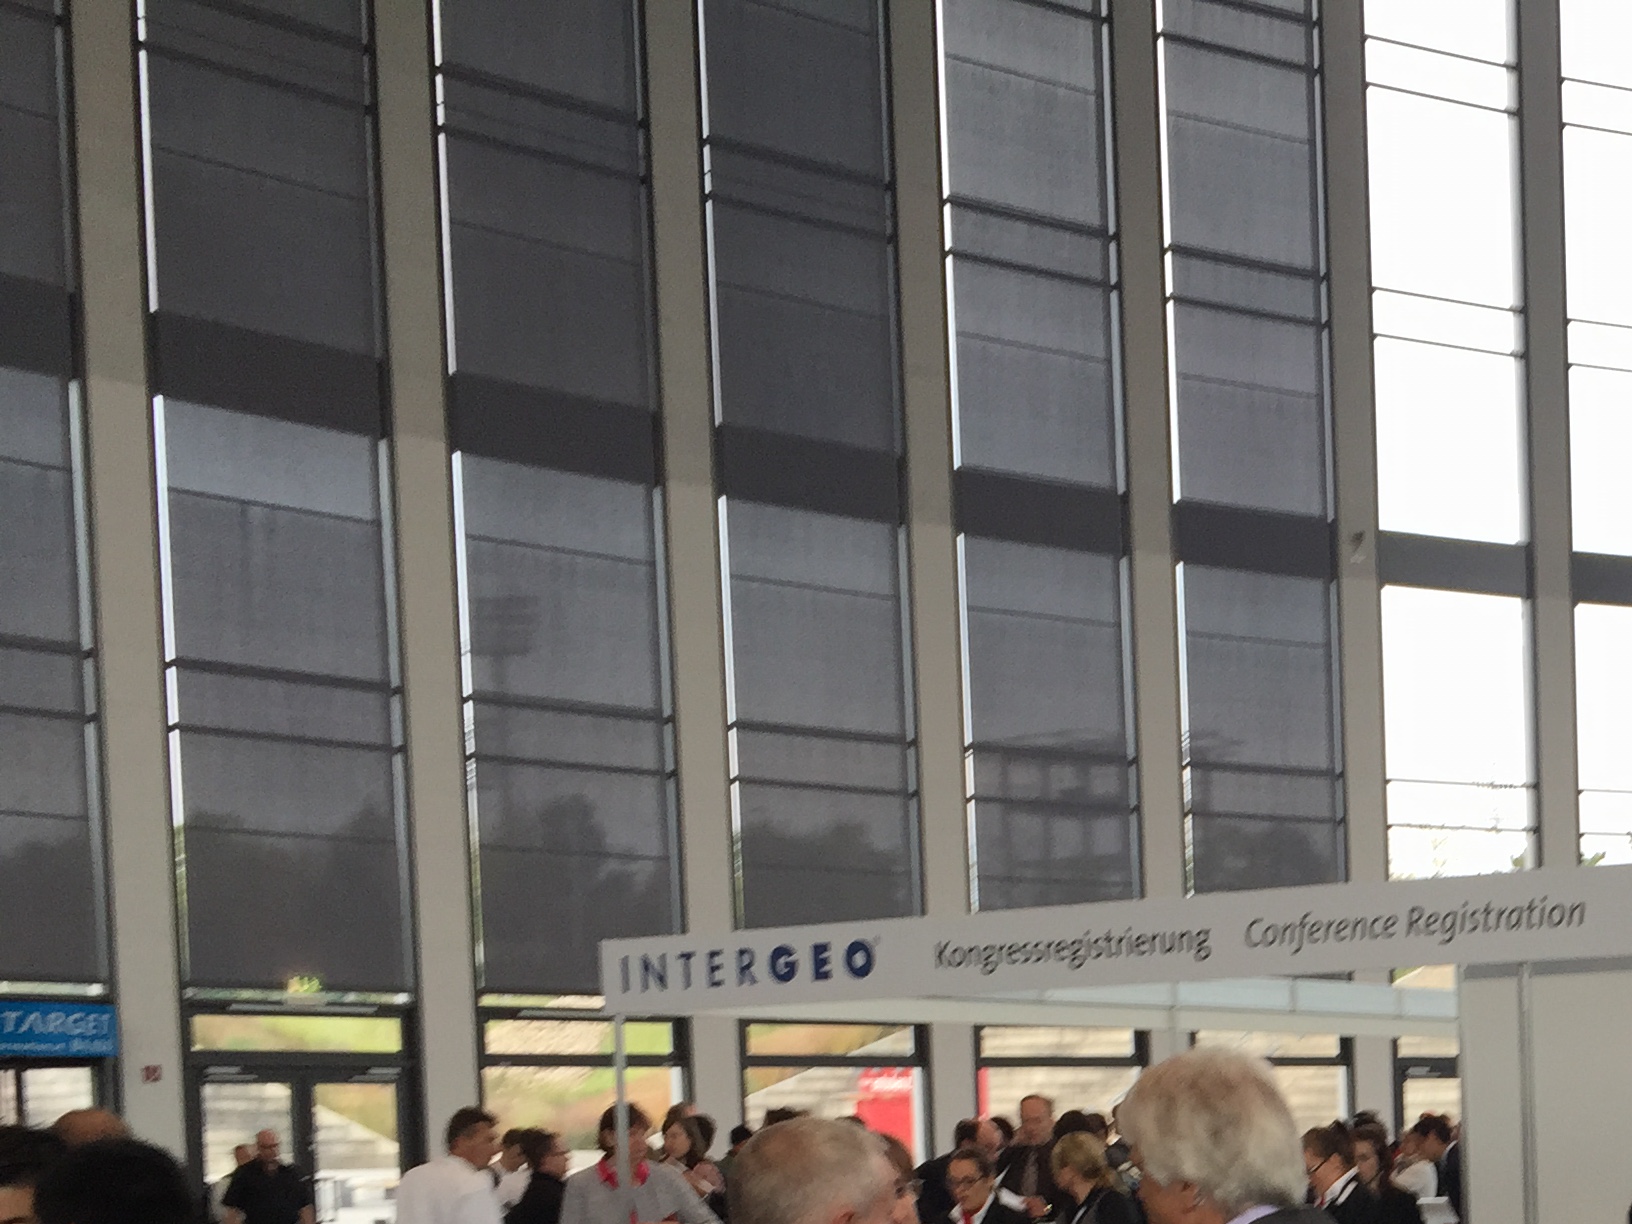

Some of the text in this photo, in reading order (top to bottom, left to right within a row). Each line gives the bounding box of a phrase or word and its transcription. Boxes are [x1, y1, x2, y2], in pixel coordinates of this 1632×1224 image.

[934, 926, 1212, 975] Kongressregistrierung
[1244, 895, 1587, 956] Conference Registration
[619, 938, 876, 994] INTERGEO
